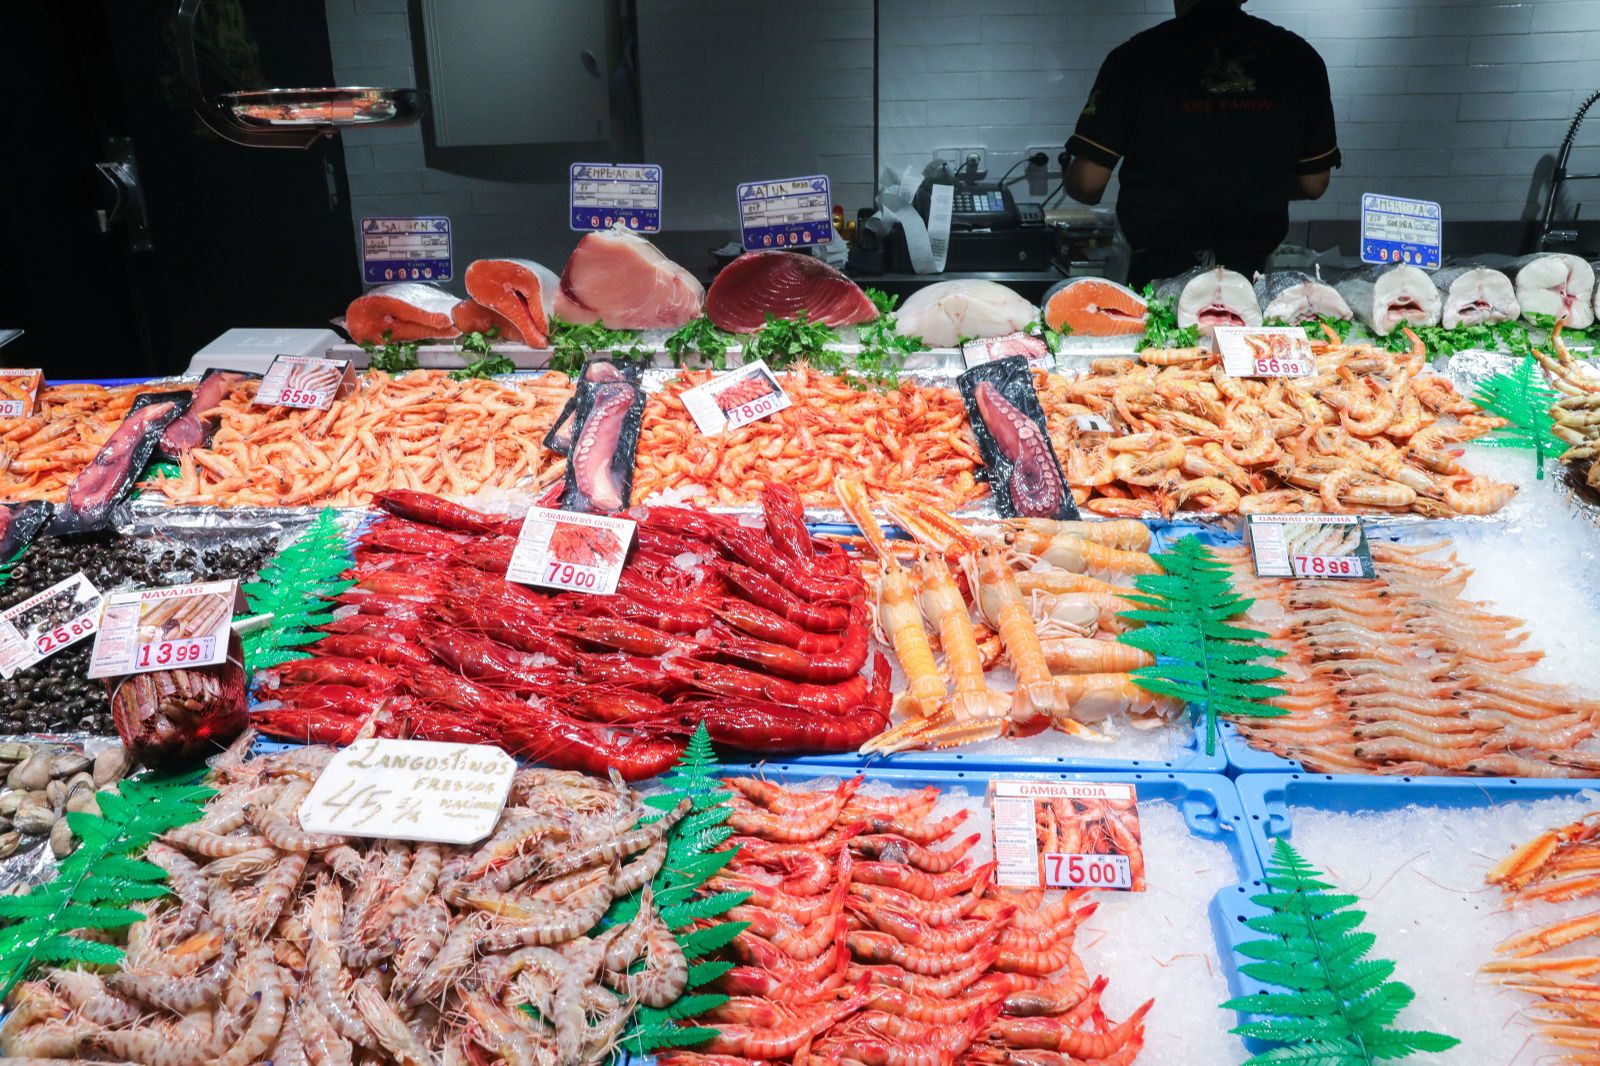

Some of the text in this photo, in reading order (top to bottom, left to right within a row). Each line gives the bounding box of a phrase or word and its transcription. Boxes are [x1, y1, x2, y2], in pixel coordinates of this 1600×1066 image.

[539, 511, 625, 529] CARABINERO GORDO
[141, 586, 204, 600] NAVAJAS
[1020, 785, 1106, 797] GAMBA ROJA
